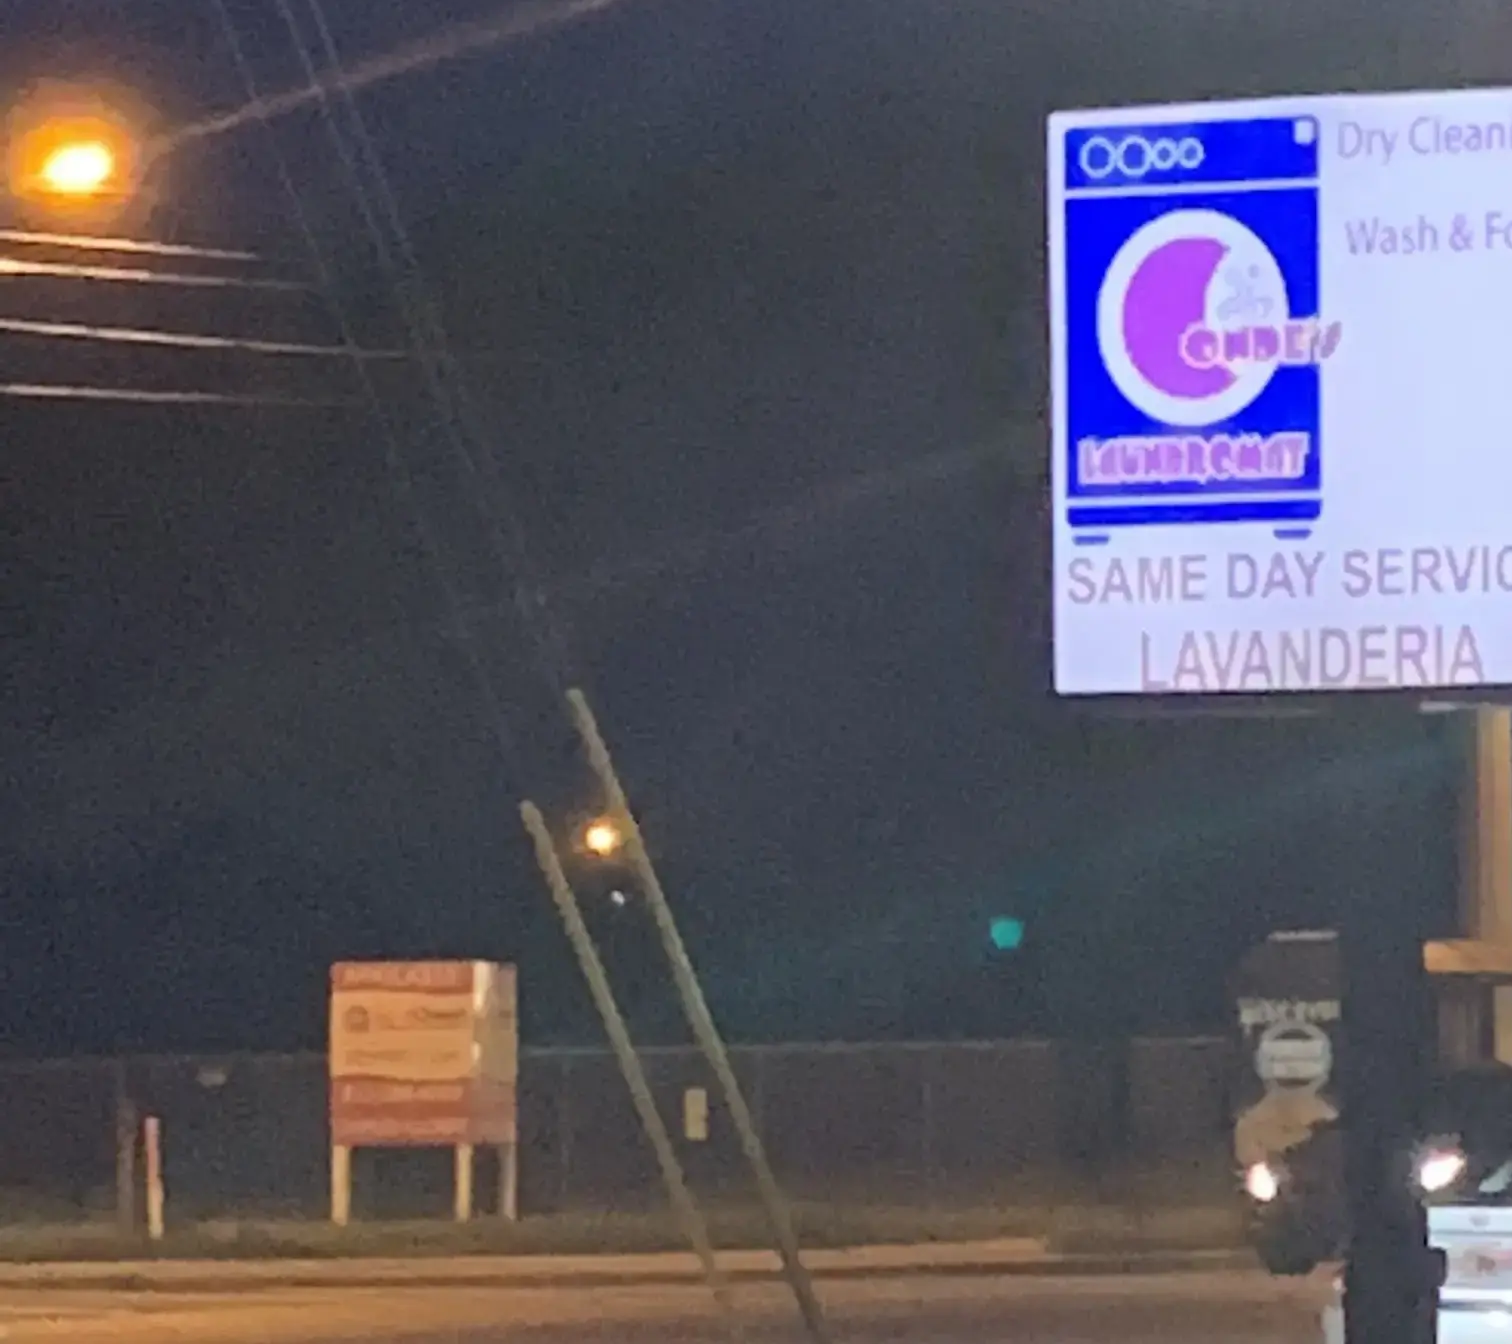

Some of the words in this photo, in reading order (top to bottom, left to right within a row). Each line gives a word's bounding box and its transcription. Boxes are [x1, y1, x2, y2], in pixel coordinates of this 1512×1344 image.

[1336, 120, 1398, 164] Dry
[1344, 214, 1440, 255] Wash
[1449, 212, 1473, 253] &
[1067, 554, 1208, 604] SAME
[1226, 551, 1327, 599] DAY
[1140, 625, 1486, 691] LAVANDERIA
